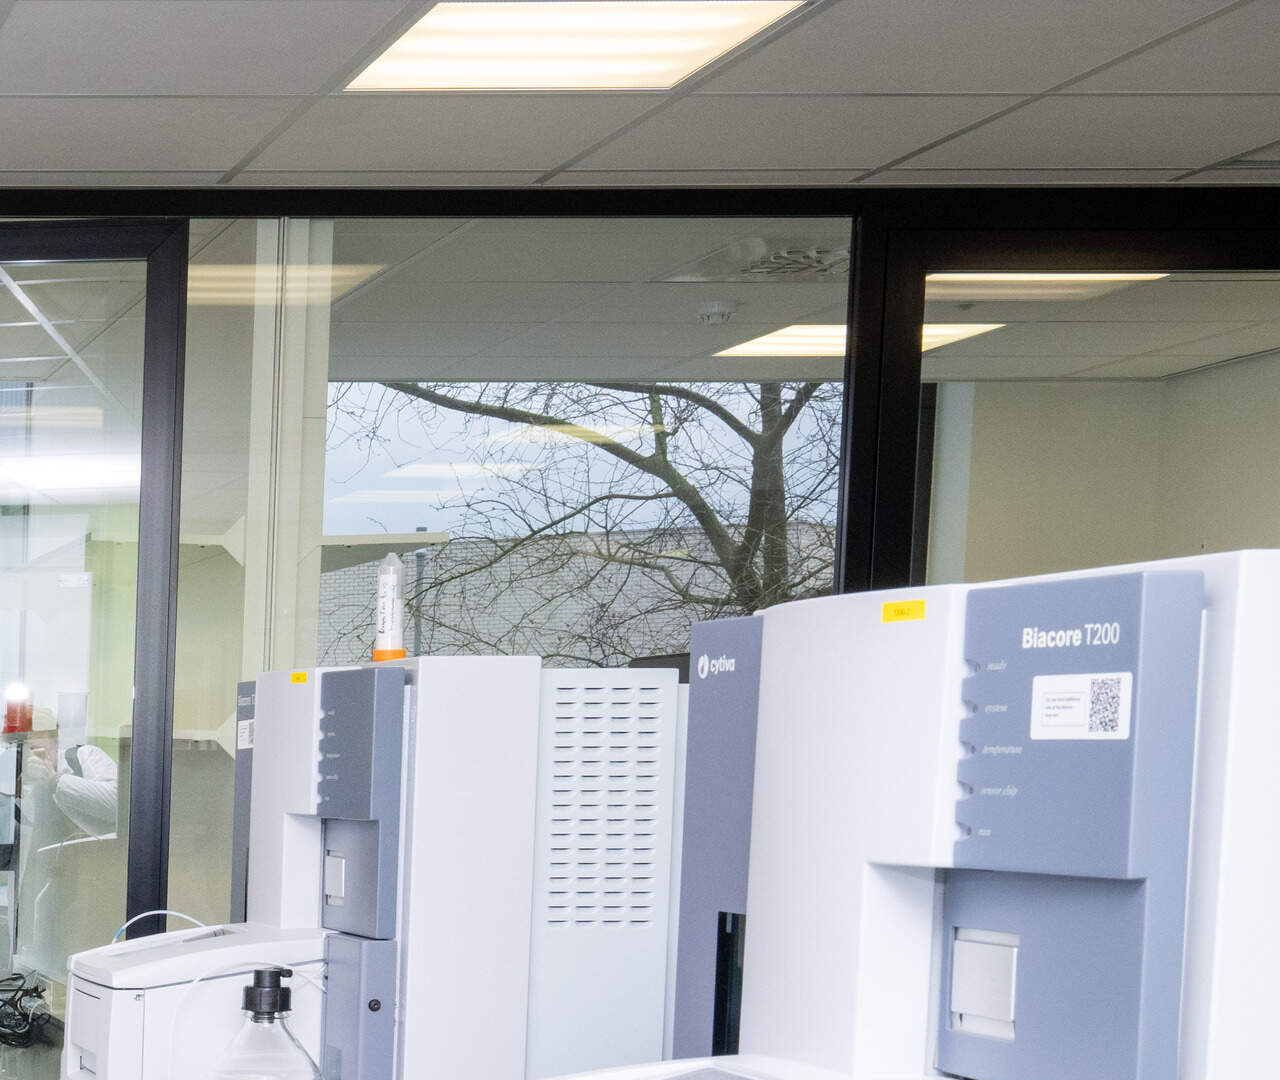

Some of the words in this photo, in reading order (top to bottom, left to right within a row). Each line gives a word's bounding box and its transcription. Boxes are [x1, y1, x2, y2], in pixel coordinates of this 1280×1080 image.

[1021, 627, 1082, 649] Biacore
[1084, 622, 1121, 646] T200
[710, 655, 736, 675] cytiva
